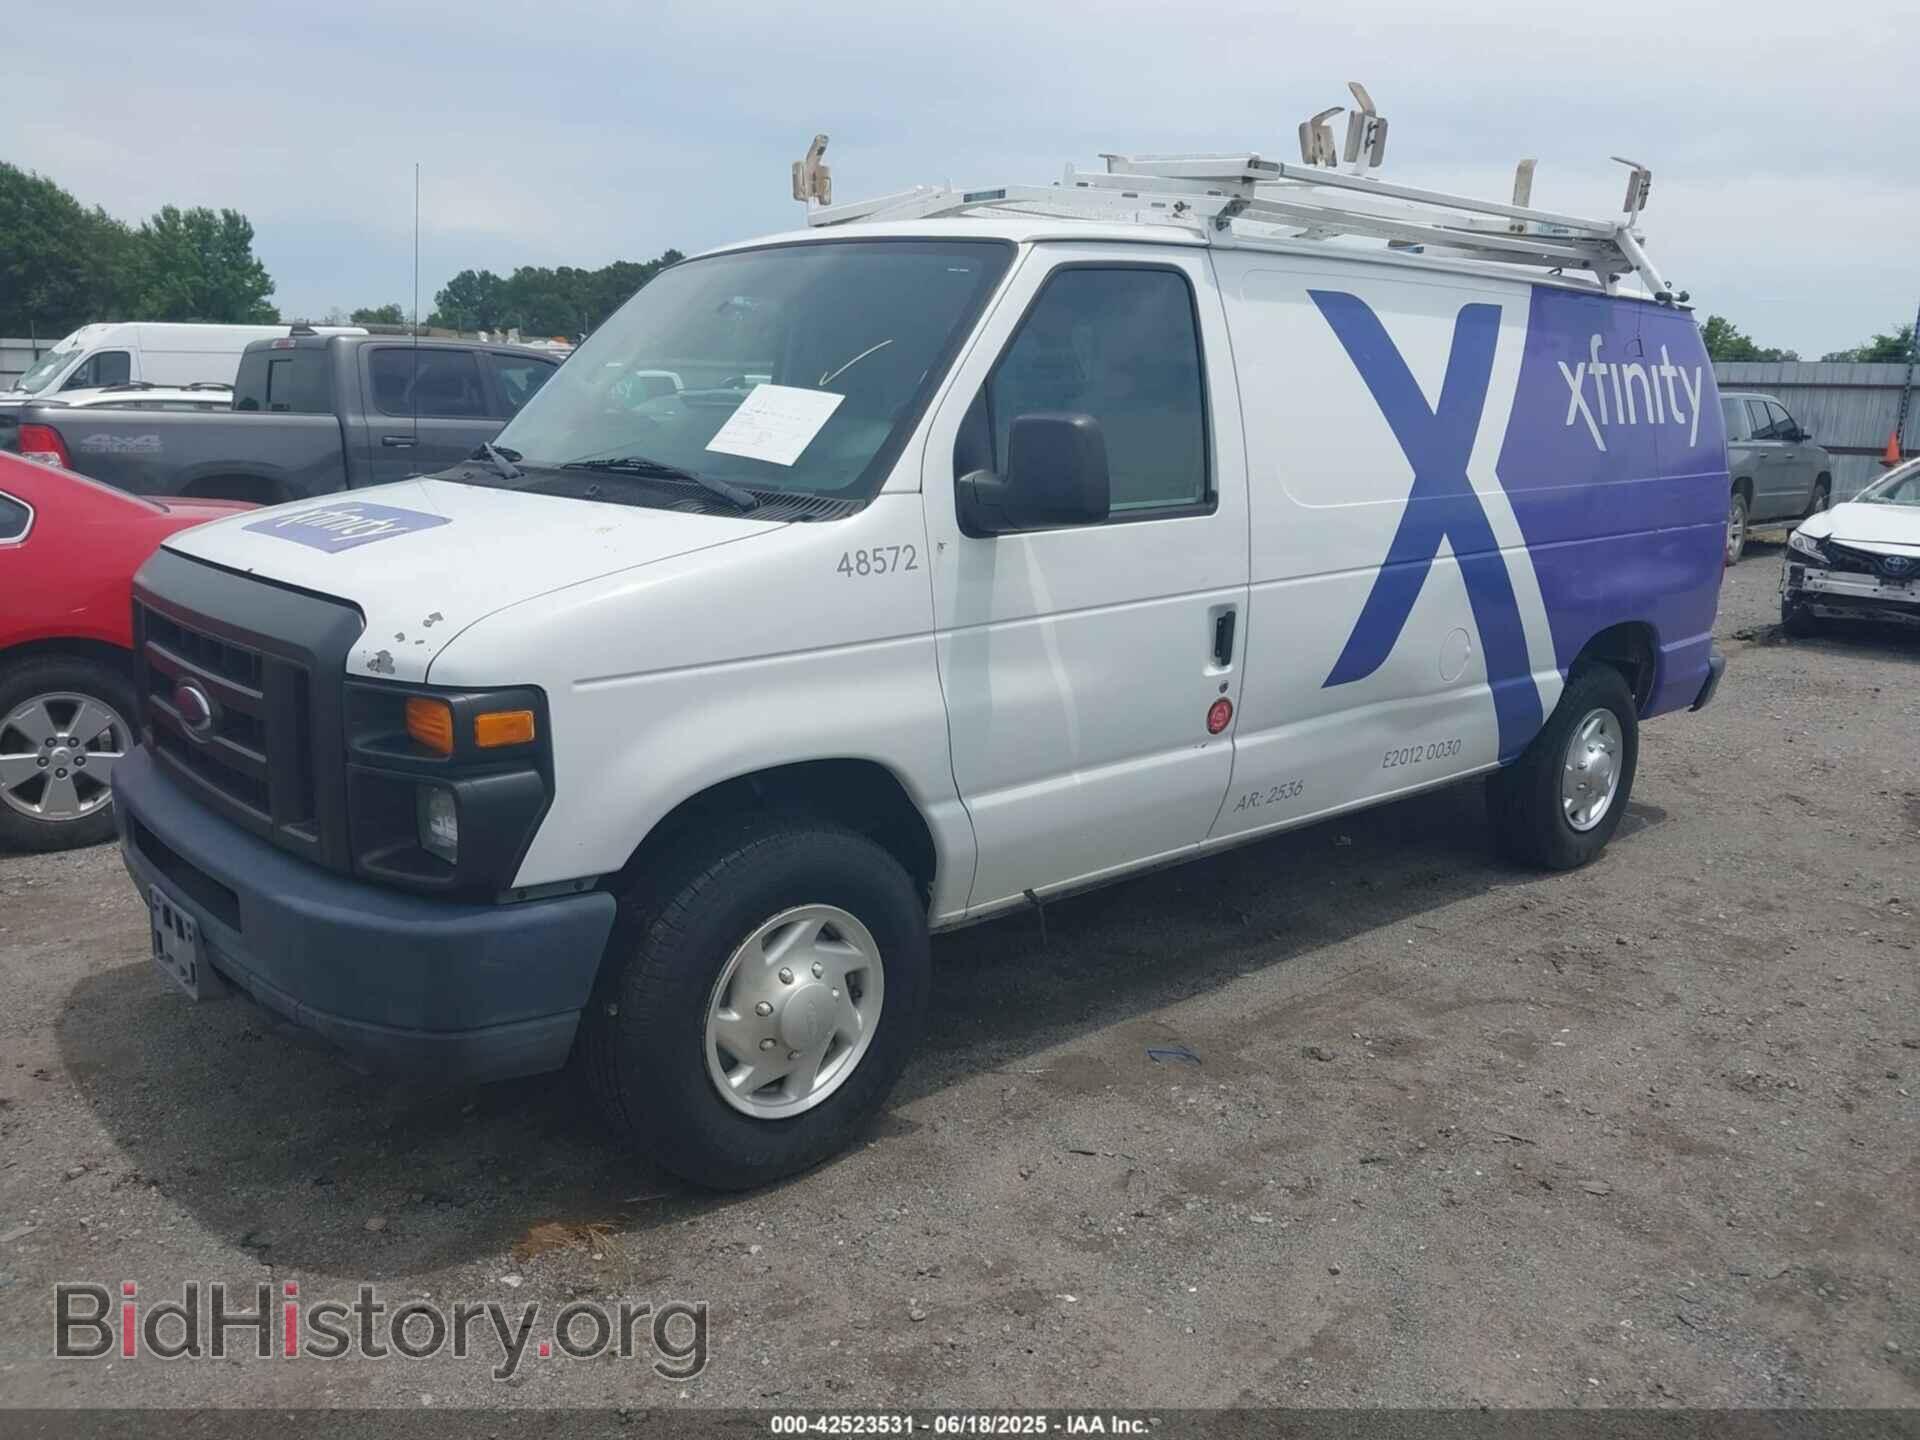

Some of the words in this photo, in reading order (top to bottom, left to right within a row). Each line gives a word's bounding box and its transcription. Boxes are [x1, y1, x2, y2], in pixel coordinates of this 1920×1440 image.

[1557, 334, 1702, 452] xfinity
[275, 508, 409, 542] xfinity
[837, 544, 919, 577] 48572
[1382, 745, 1424, 769] E2012
[1266, 780, 1305, 805] 2536
